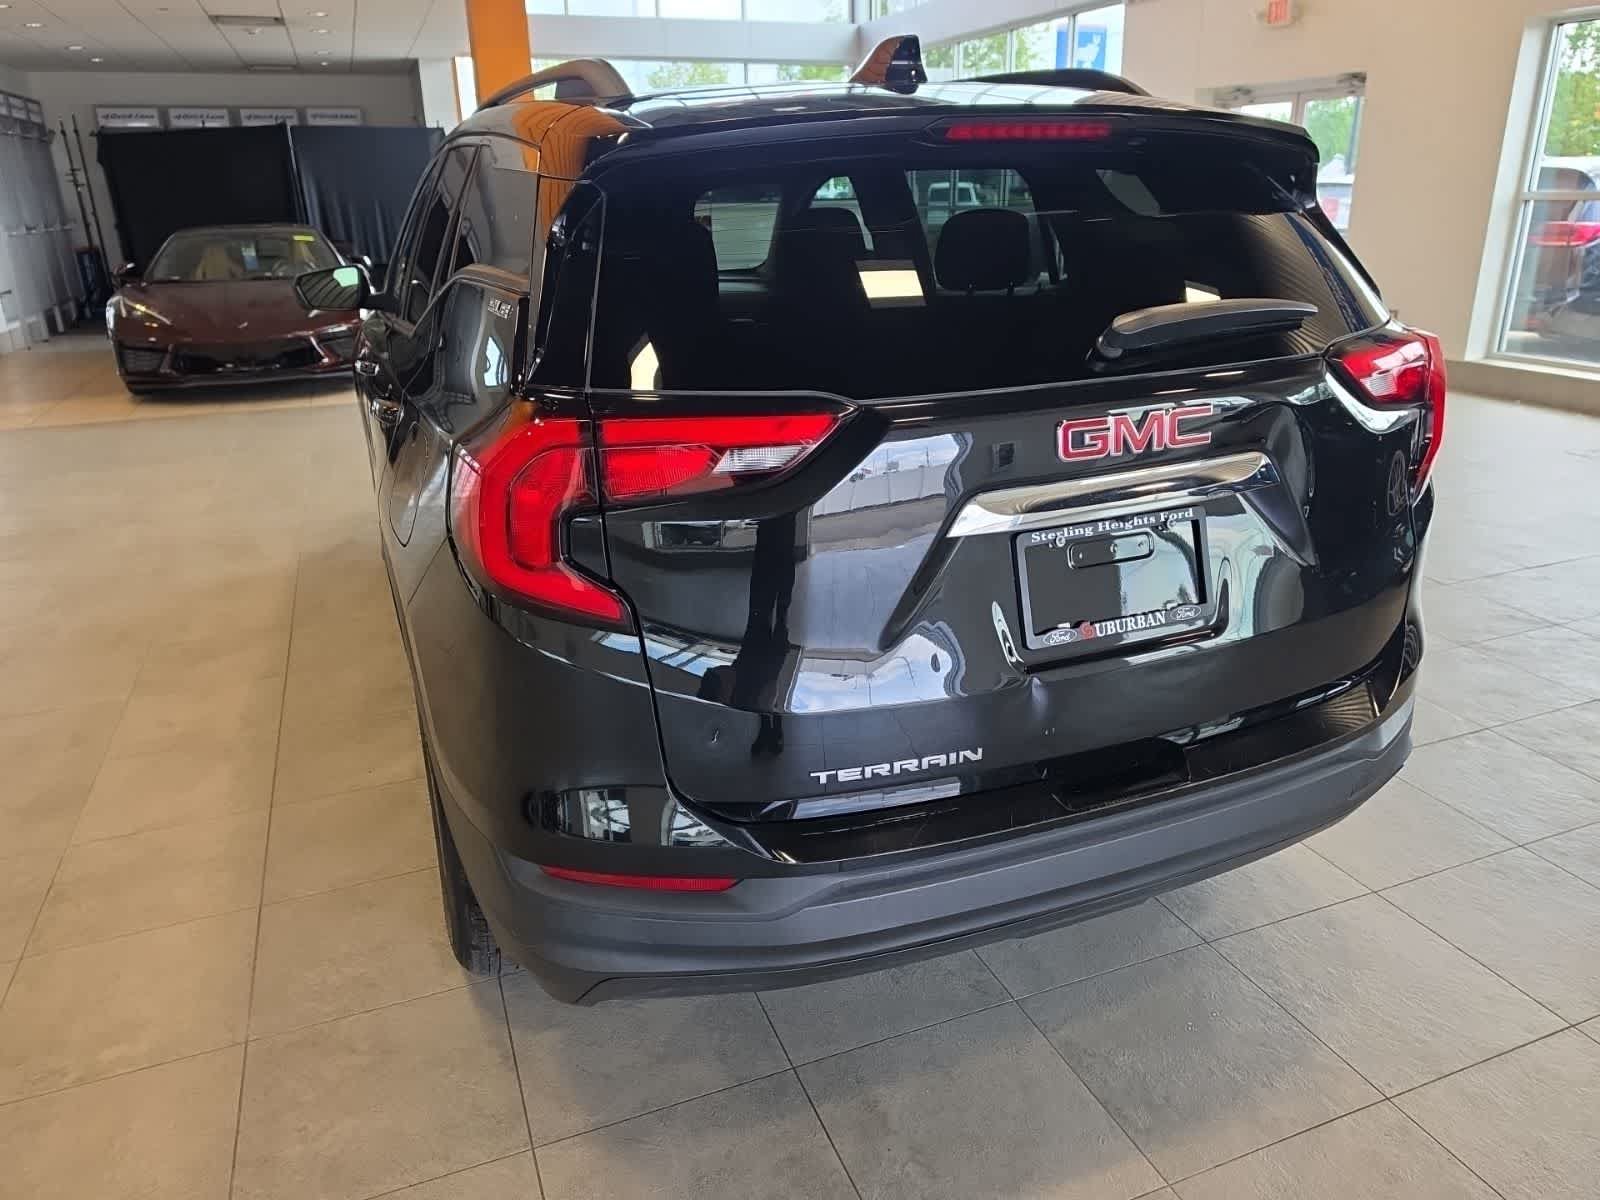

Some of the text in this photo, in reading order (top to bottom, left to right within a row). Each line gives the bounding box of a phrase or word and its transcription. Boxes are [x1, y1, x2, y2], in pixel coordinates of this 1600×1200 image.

[1057, 404, 1213, 463] GMC
[1031, 507, 1194, 544] Sterling Heights Ford
[1048, 630, 1073, 643] Ford
[809, 747, 983, 784] TERRAIN
